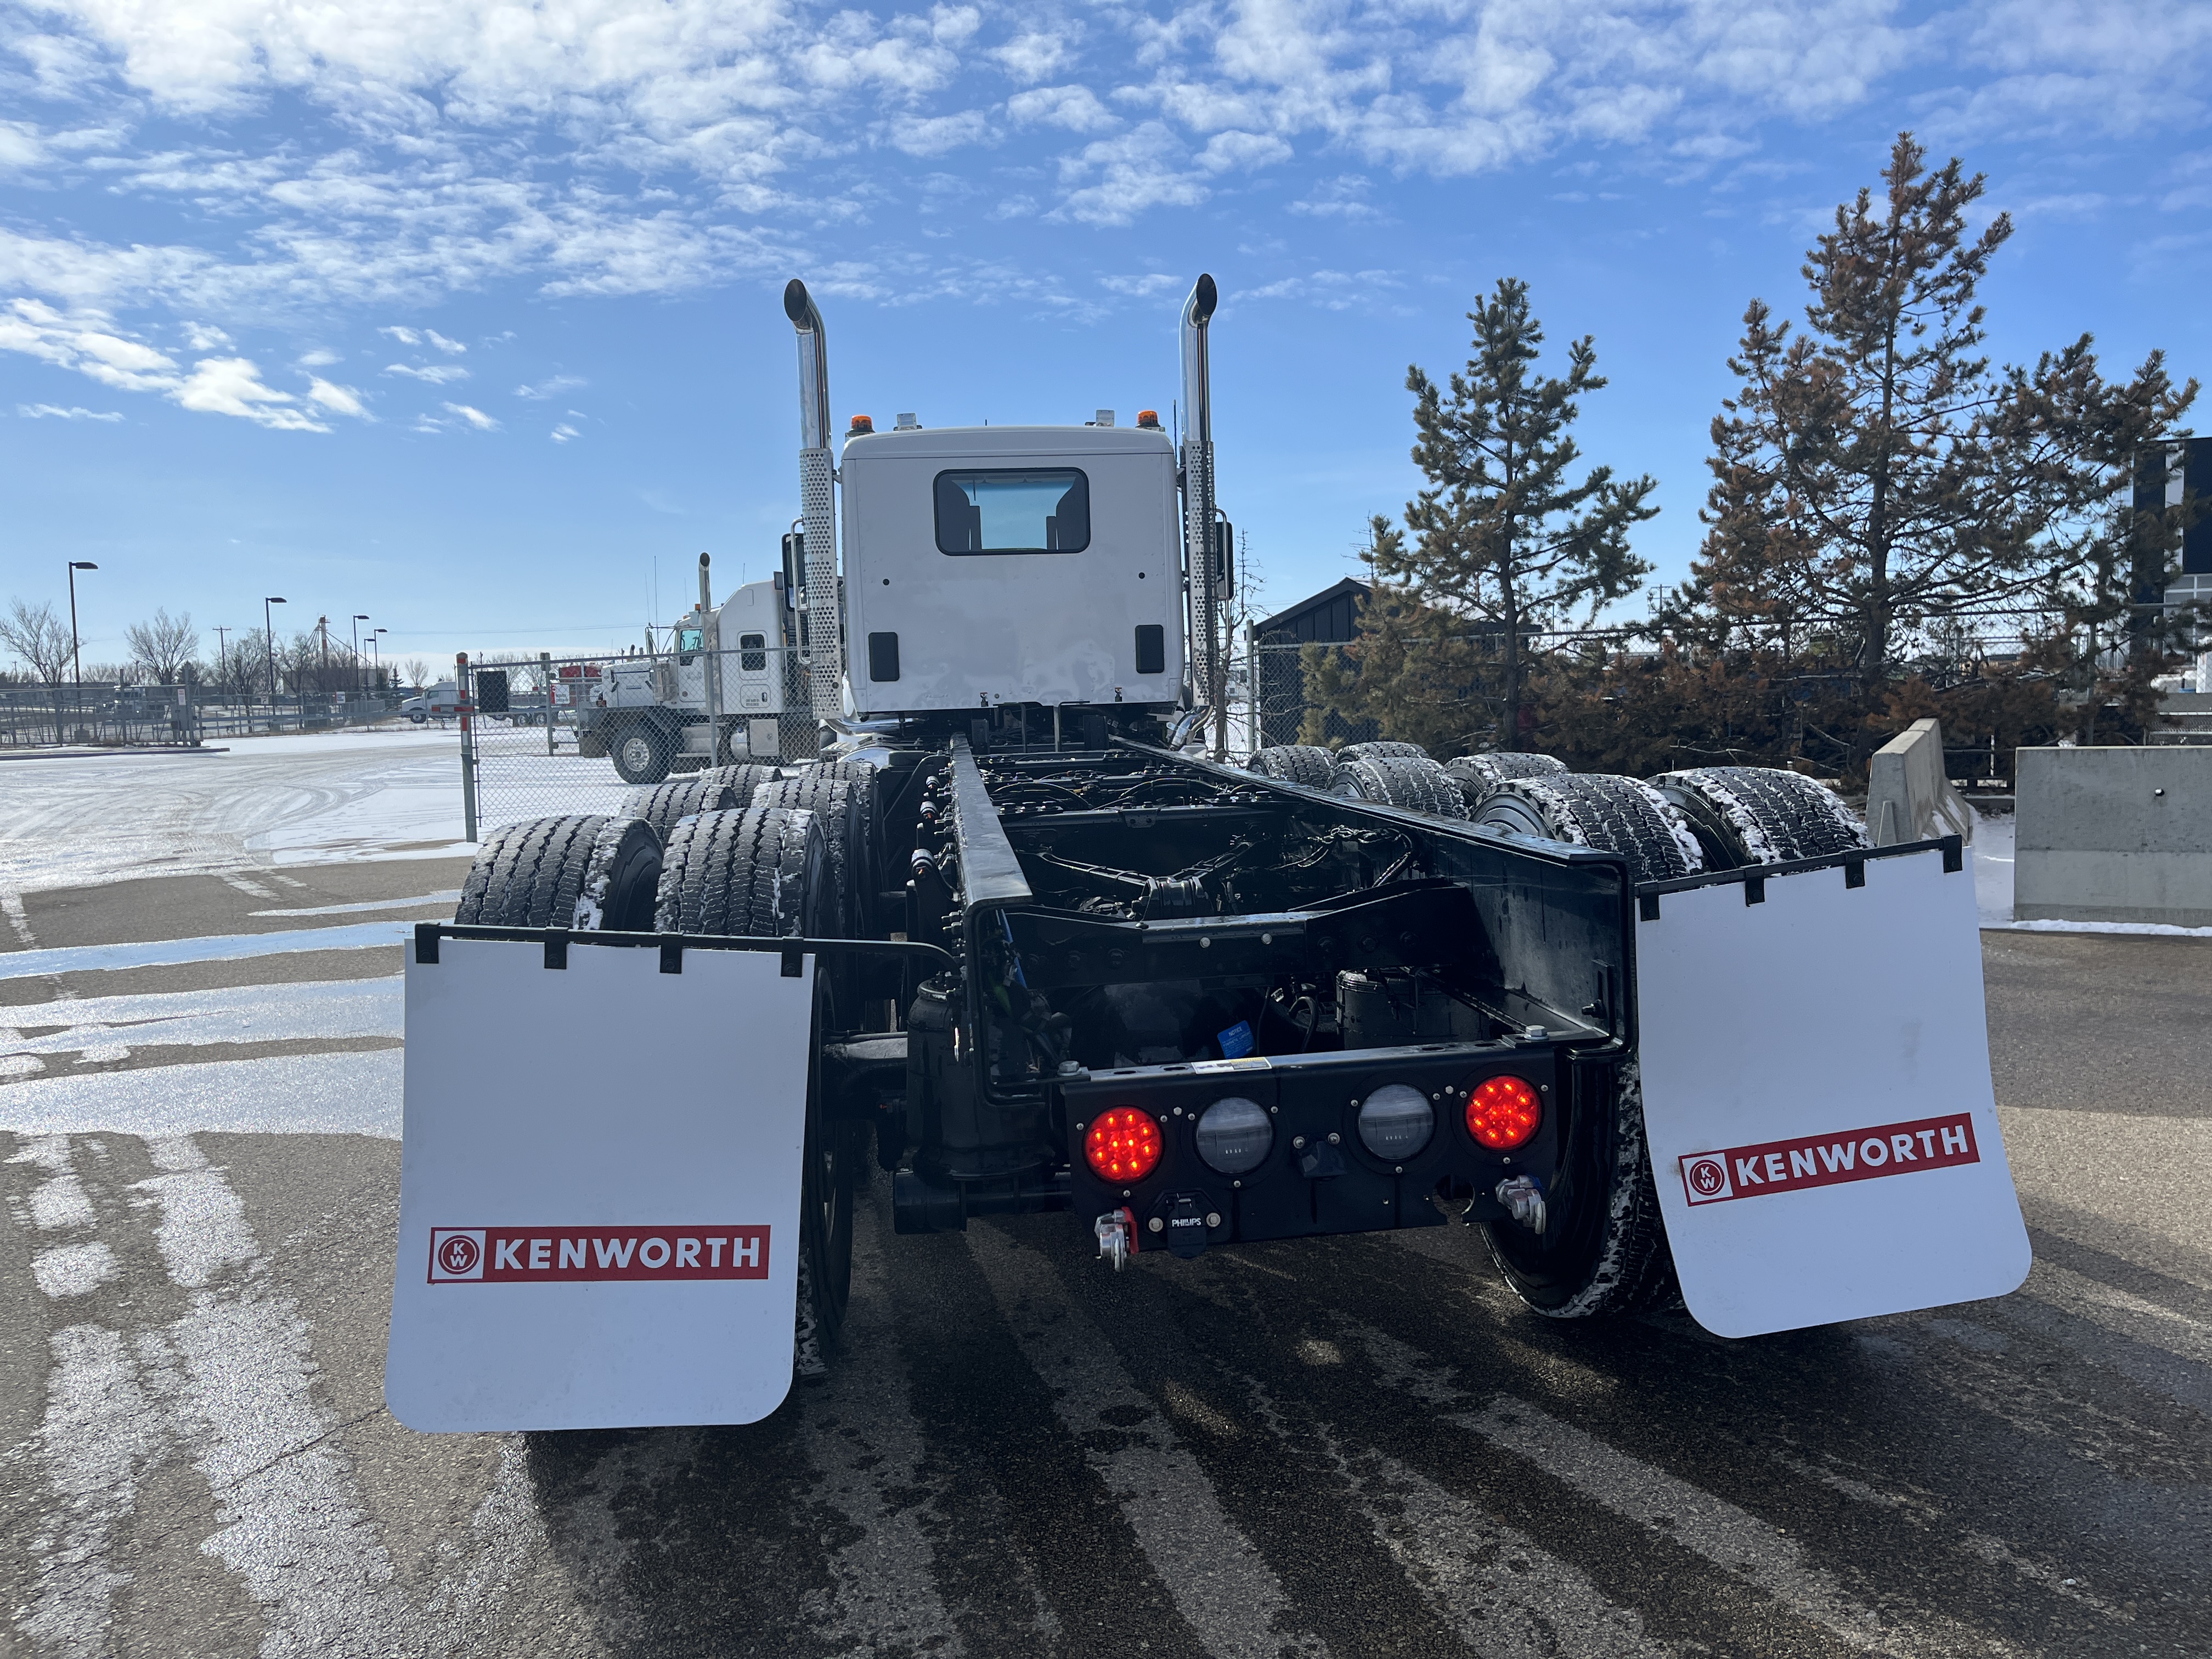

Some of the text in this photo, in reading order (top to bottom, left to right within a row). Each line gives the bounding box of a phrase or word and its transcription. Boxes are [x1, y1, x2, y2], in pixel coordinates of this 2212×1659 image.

[1228, 1026, 1243, 1036] NOTICE
[1735, 1125, 1968, 1187] KENWORTH
[1172, 1217, 1201, 1227] PHILLIPS
[494, 1237, 760, 1269] KENWORTH
